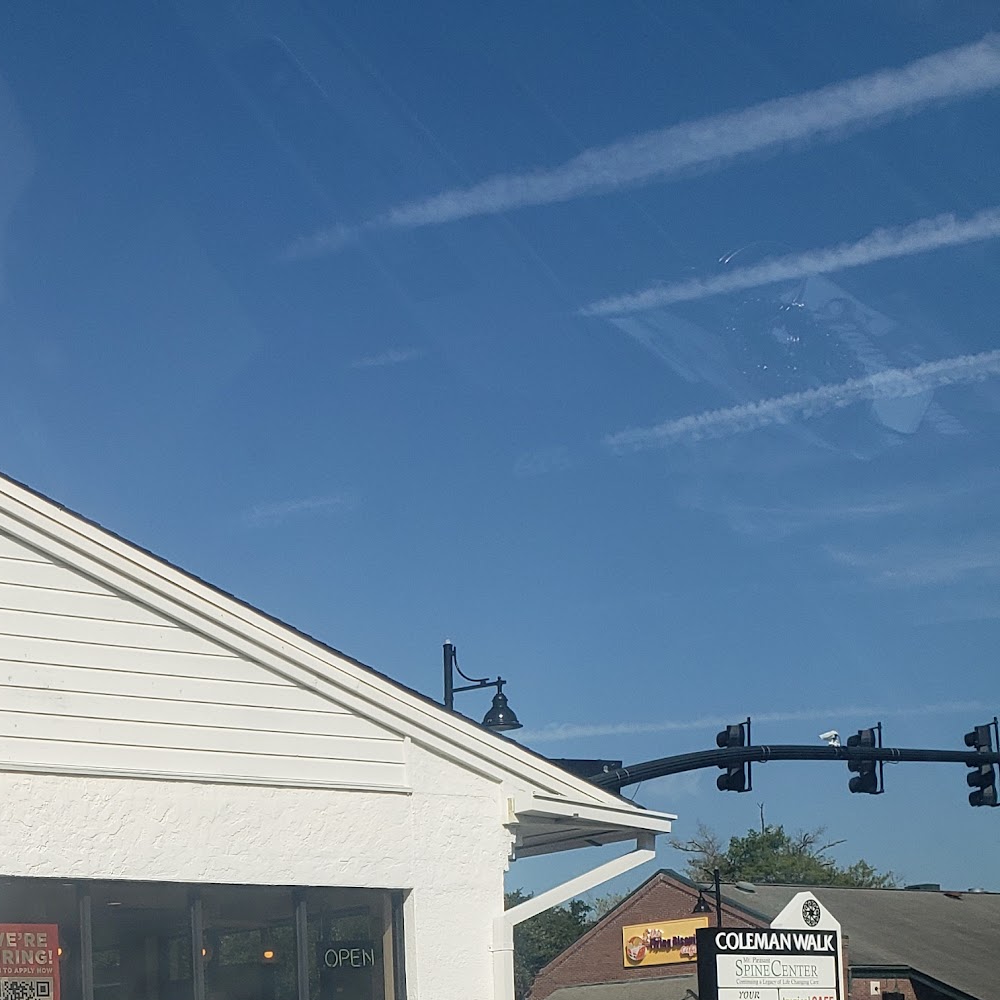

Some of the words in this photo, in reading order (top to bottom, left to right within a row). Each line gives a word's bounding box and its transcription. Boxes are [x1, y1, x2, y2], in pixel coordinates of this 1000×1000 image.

[715, 932, 792, 951] COLEMAN
[792, 933, 835, 952] WALK
[324, 948, 375, 968] OPEN
[739, 991, 760, 999] YOUR
